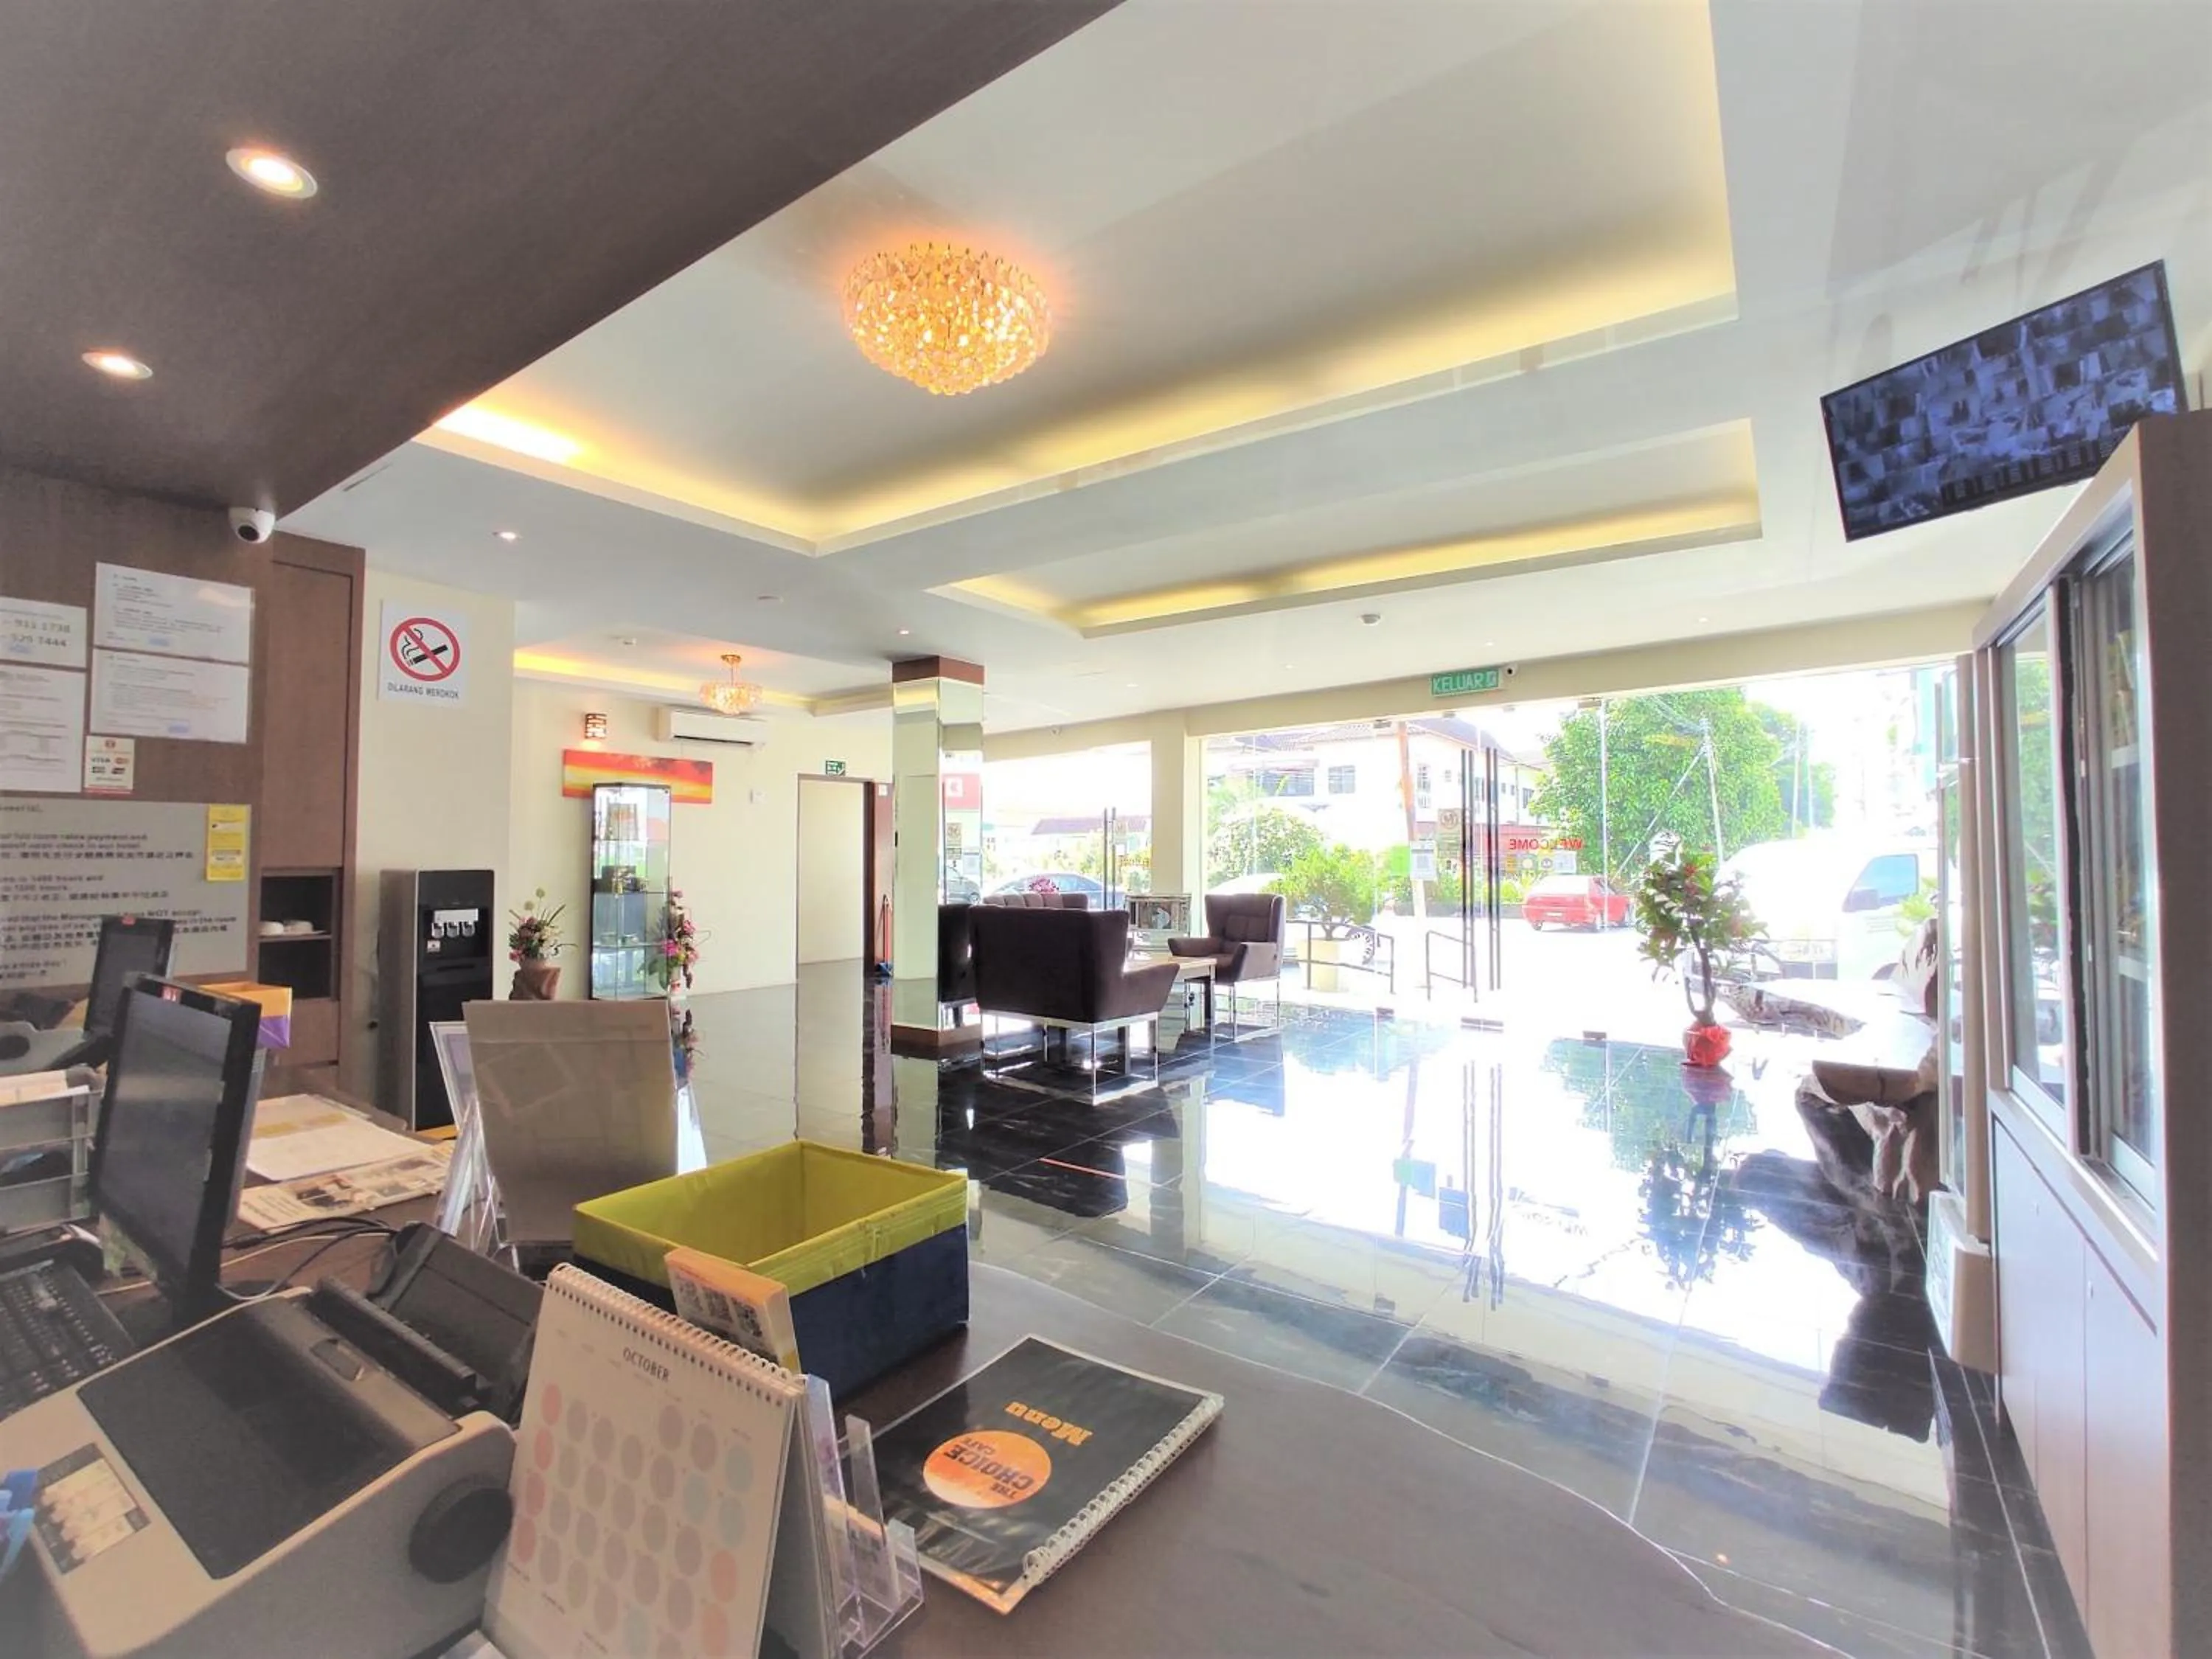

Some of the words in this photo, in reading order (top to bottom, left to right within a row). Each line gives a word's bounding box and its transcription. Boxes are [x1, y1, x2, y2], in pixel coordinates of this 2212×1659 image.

[387, 682, 423, 695] DILARANG
[1433, 672, 1484, 692] KELUAR
[622, 1346, 669, 1383] OCTOBER
[1005, 1401, 1093, 1446] Menu
[944, 1444, 1034, 1491] CHOICE
[991, 1482, 1019, 1500] THE
